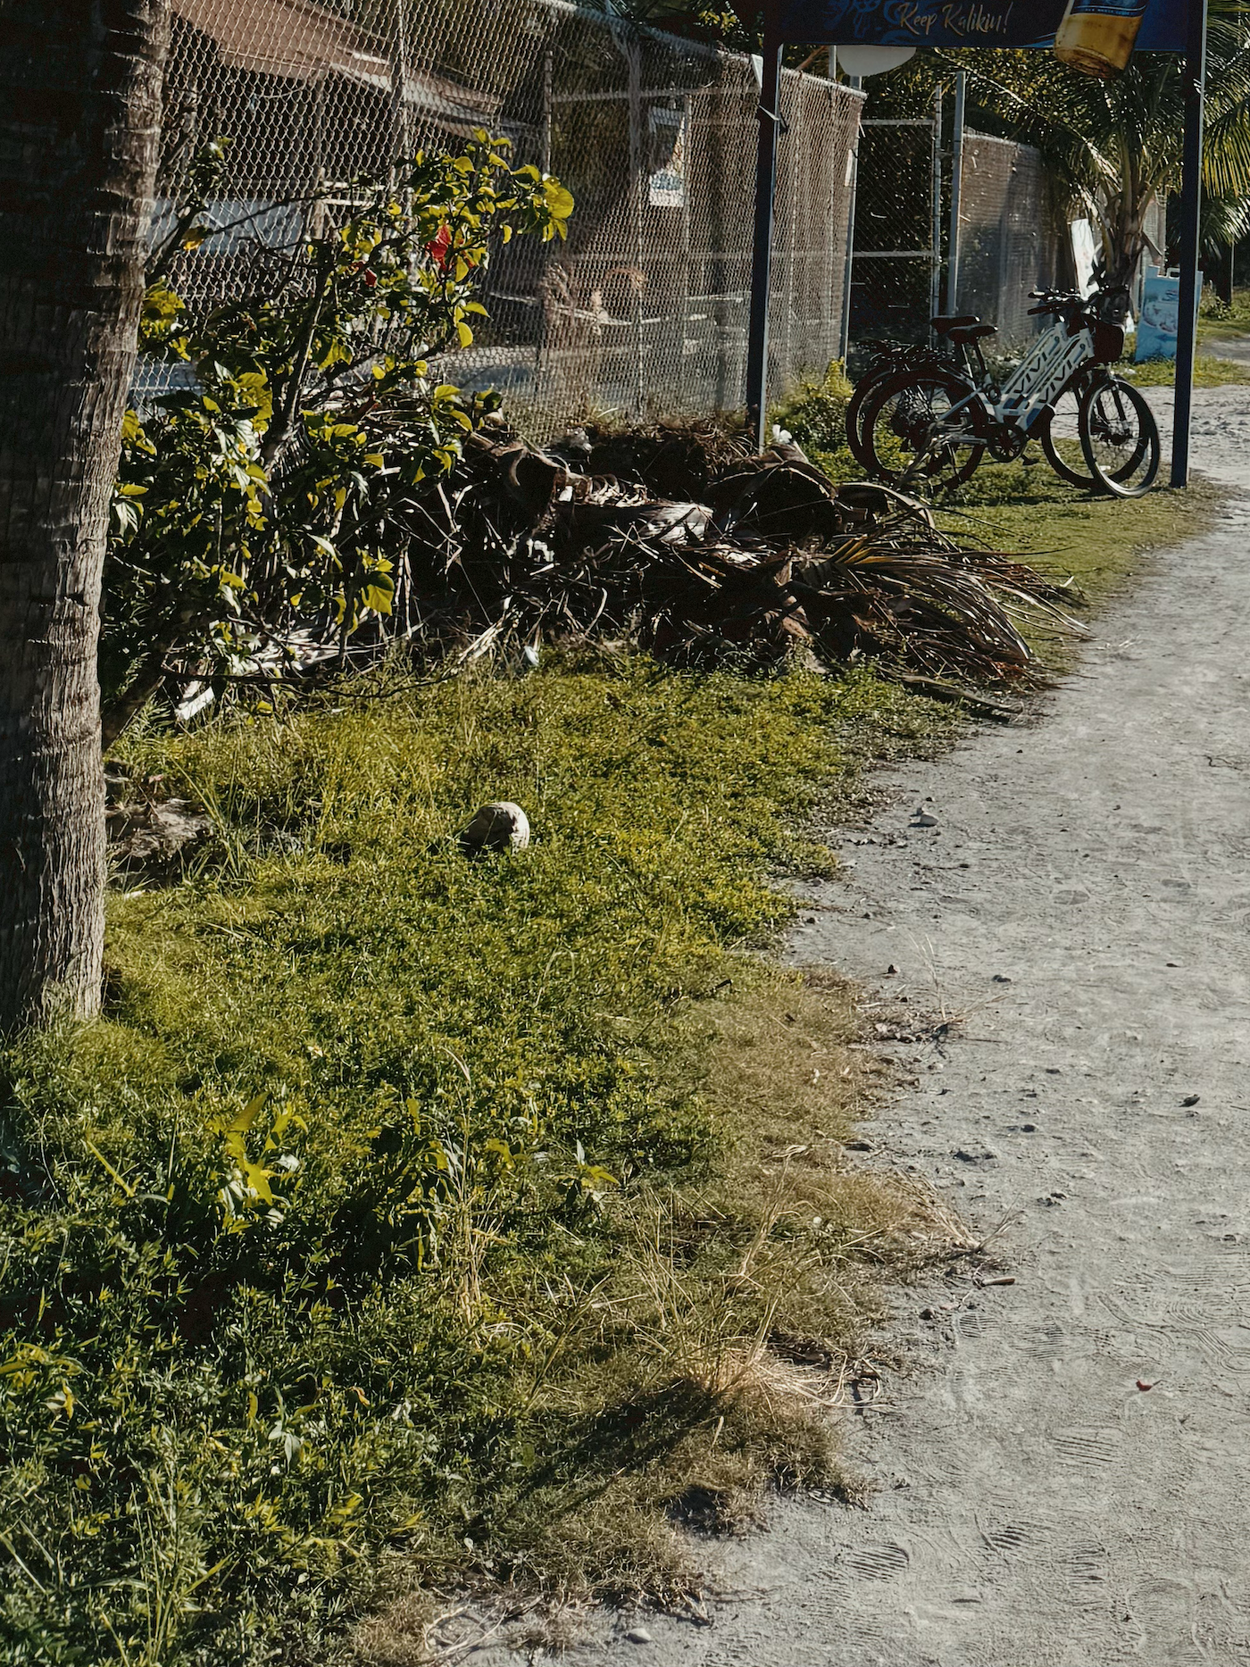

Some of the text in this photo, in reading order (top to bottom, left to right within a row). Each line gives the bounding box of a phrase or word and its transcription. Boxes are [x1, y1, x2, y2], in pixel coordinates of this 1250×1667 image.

[898, 1, 1013, 36] Keep Kalikin!
[1013, 351, 1048, 394] VIVI
[1037, 359, 1073, 404] VIVI
